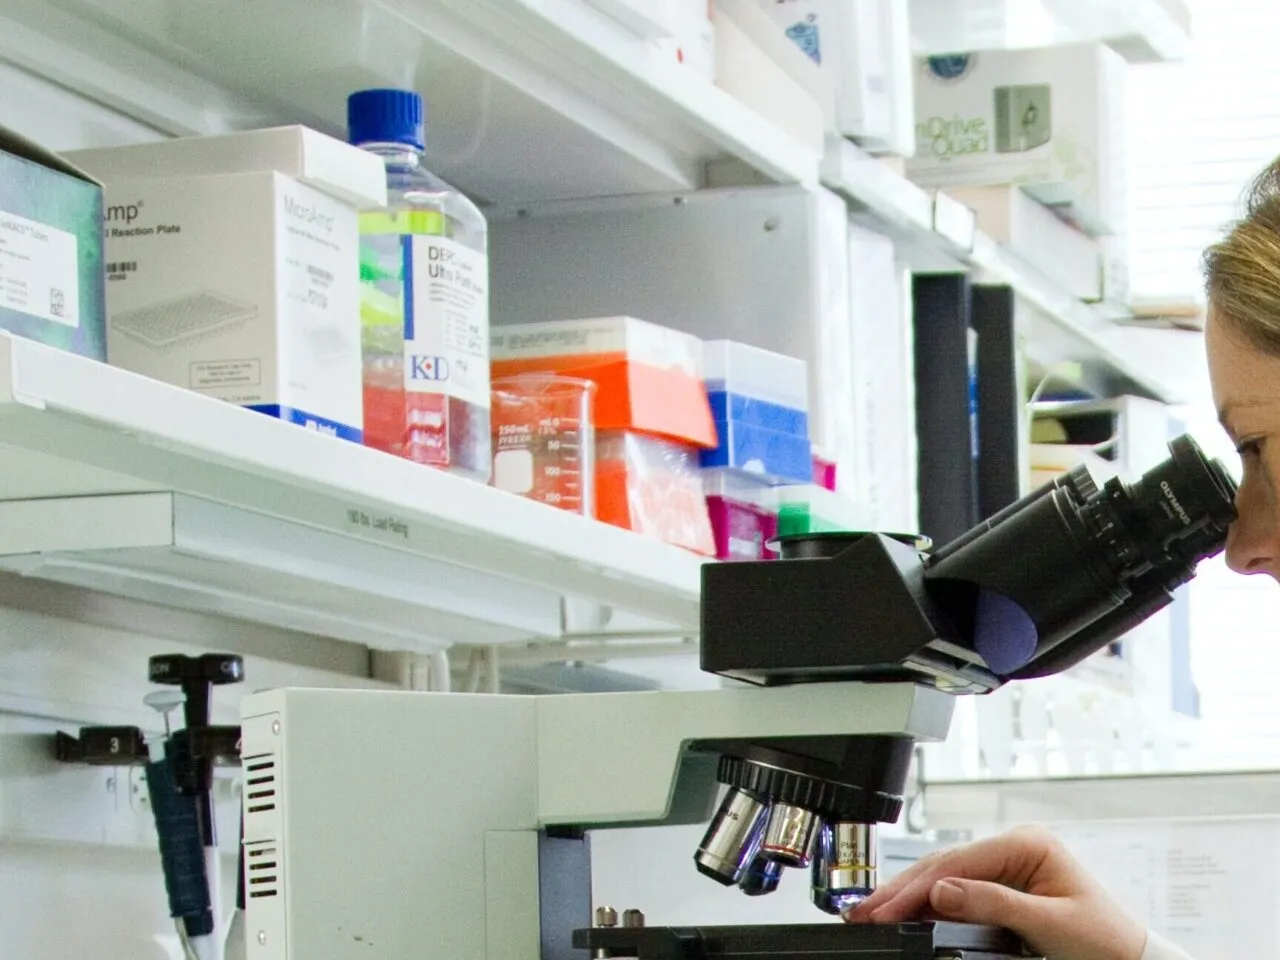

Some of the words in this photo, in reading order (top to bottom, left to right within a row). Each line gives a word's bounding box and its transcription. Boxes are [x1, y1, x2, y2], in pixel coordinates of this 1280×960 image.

[111, 228, 154, 237] Reaction
[156, 224, 181, 235] Plate
[547, 440, 560, 451] 50
[544, 465, 561, 477] 100
[1160, 480, 1192, 526] OLYMPUS
[109, 737, 120, 753] 3
